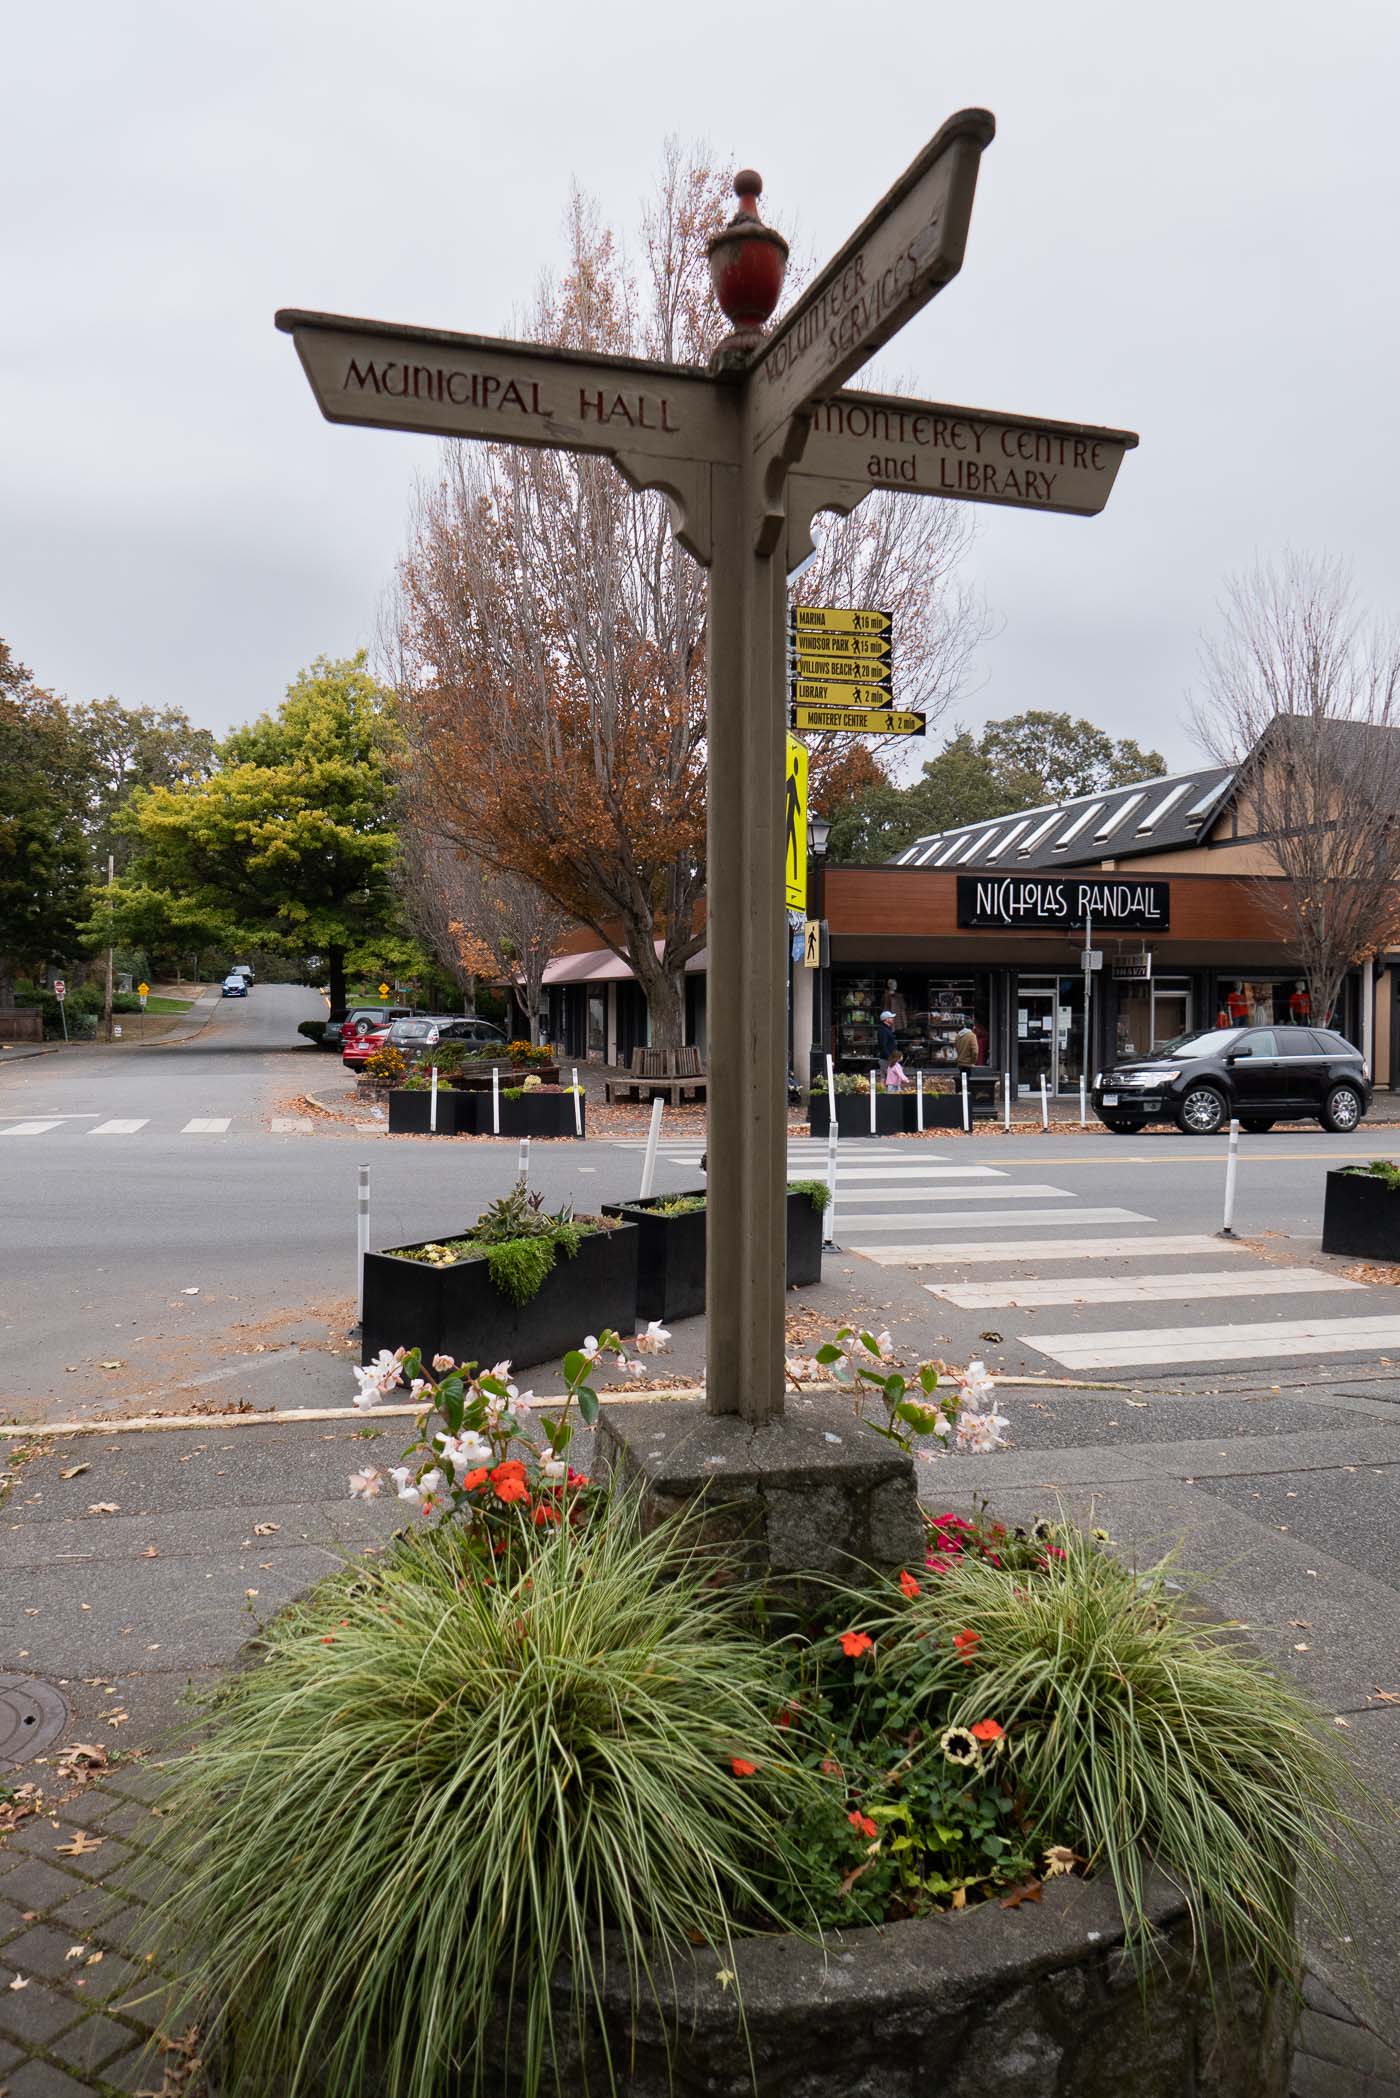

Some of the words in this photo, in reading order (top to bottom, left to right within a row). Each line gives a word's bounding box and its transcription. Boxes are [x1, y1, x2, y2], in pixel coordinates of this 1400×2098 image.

[765, 254, 865, 383] VOLUNTEER
[828, 243, 917, 364] SERVICES
[342, 359, 554, 417] MUNICIPAL
[578, 389, 681, 433] HALL
[813, 402, 990, 453] MONTEREY
[1000, 428, 1106, 472] CENTRE
[867, 454, 917, 482] and
[940, 458, 1057, 501] LIBRARY
[799, 613, 826, 626] MARINA
[861, 616, 870, 628] 16
[871, 617, 883, 629] min
[799, 637, 831, 650] WINDSOR
[832, 639, 849, 652] PARK
[861, 641, 869, 652] 15
[870, 642, 882, 654] min
[800, 661, 830, 674] WILLOWS
[831, 663, 852, 676] BEACH
[861, 666, 870, 677] 20
[871, 666, 883, 678] min
[799, 685, 828, 699] LIBRARY
[865, 690, 870, 702] 2
[871, 690, 883, 702] min
[807, 712, 843, 726] MONTEREY
[843, 714, 868, 727] CENTRE
[897, 718, 903, 730] 2
[903, 718, 915, 730] min
[977, 878, 1067, 922] NICHOLAS
[1078, 885, 1161, 918] RANDALL
